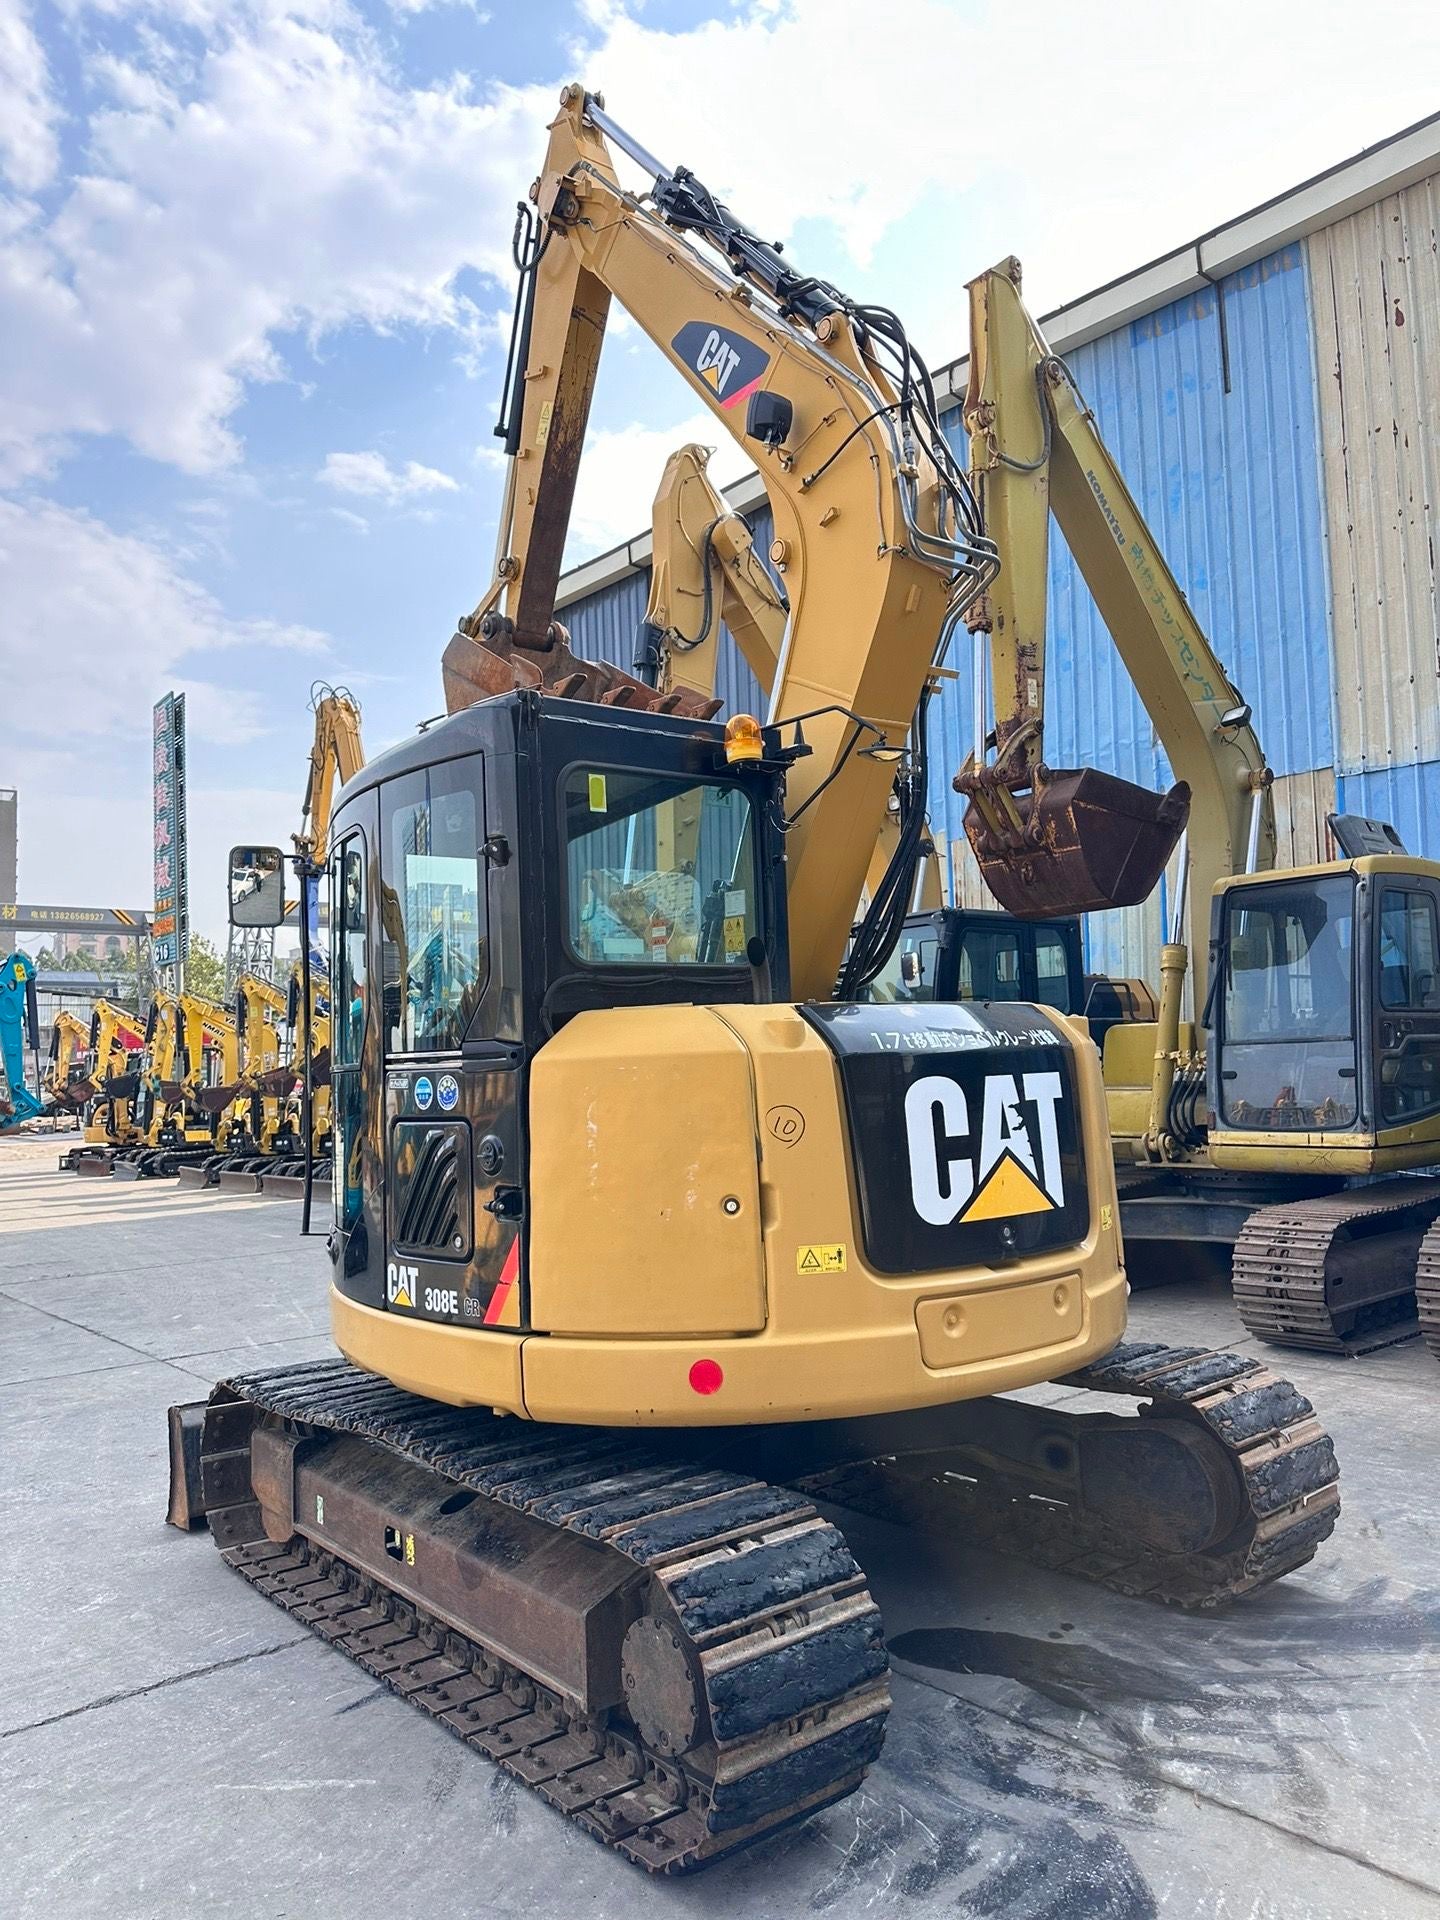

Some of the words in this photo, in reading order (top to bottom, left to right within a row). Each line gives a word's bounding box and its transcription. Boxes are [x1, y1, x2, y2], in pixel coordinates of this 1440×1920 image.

[696, 329, 741, 395] CAT
[1087, 469, 1126, 546] KOMATSU
[1, 904, 18, 919] 材
[904, 1072, 1065, 1226] CAT
[387, 1262, 419, 1308] CAT
[424, 1287, 459, 1315] 308E
[463, 1297, 481, 1317] CR
